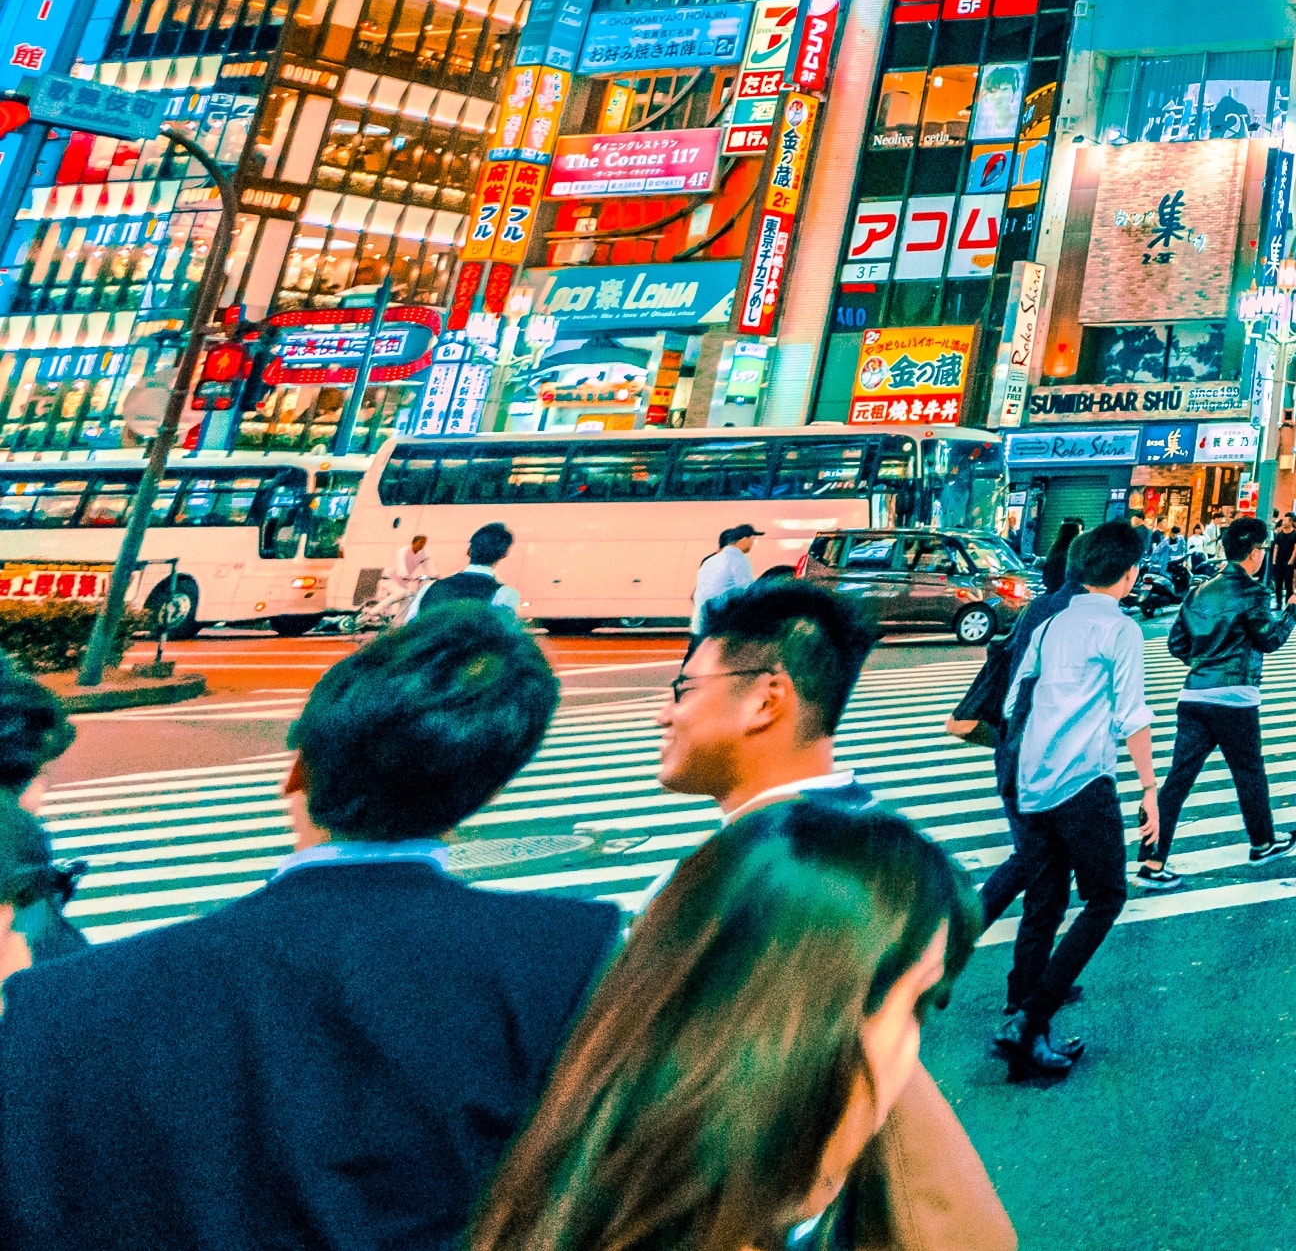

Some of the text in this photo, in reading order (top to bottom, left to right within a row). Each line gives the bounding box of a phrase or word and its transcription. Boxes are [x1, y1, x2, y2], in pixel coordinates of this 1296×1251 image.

[802, 19, 828, 70] アコム
[873, 134, 914, 146] Neolive
[566, 148, 699, 169] The Corner 117
[852, 209, 999, 255] アコム
[856, 265, 878, 279] 3F
[888, 354, 962, 388] 金の蔵
